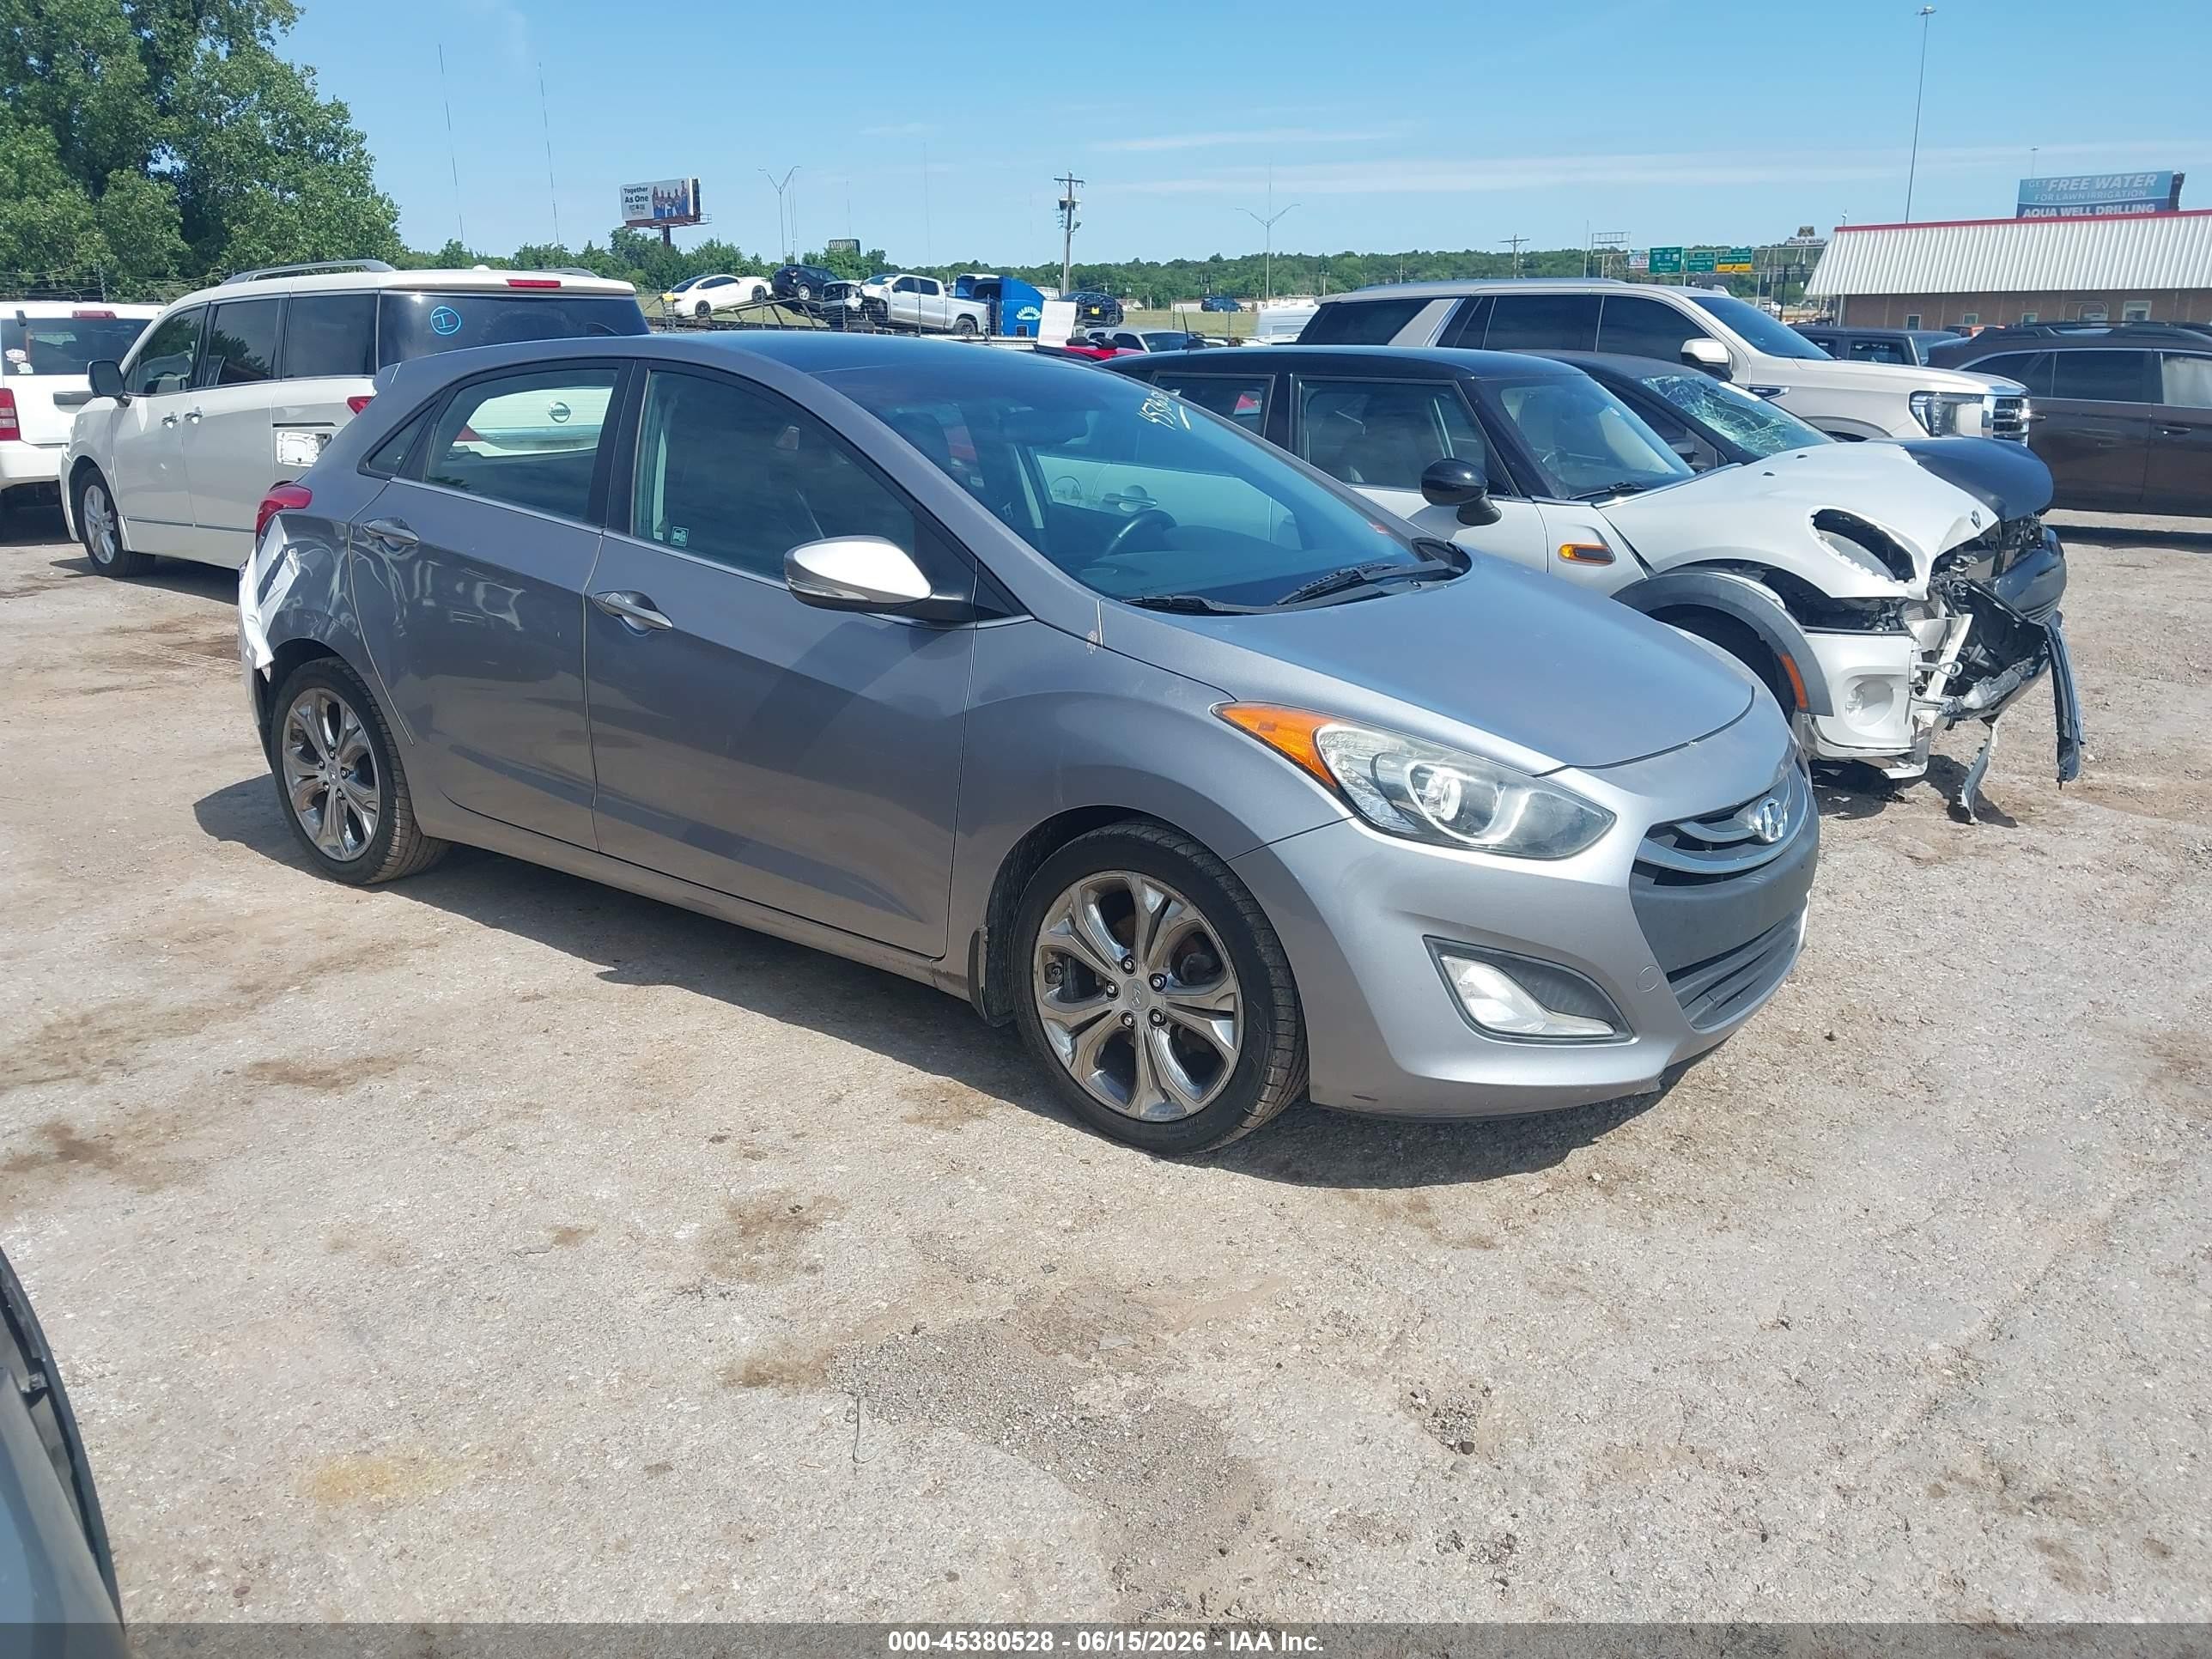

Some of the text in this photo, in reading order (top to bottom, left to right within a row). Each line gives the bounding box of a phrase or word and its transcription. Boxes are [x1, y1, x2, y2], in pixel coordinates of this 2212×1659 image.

[2048, 177, 2093, 191] FREE
[2095, 173, 2158, 189] WATER
[623, 186, 648, 195] Together
[2034, 189, 2147, 202] FOR LAWN IRRIGATION
[2022, 204, 2155, 218] AQUA WELL DRILLING
